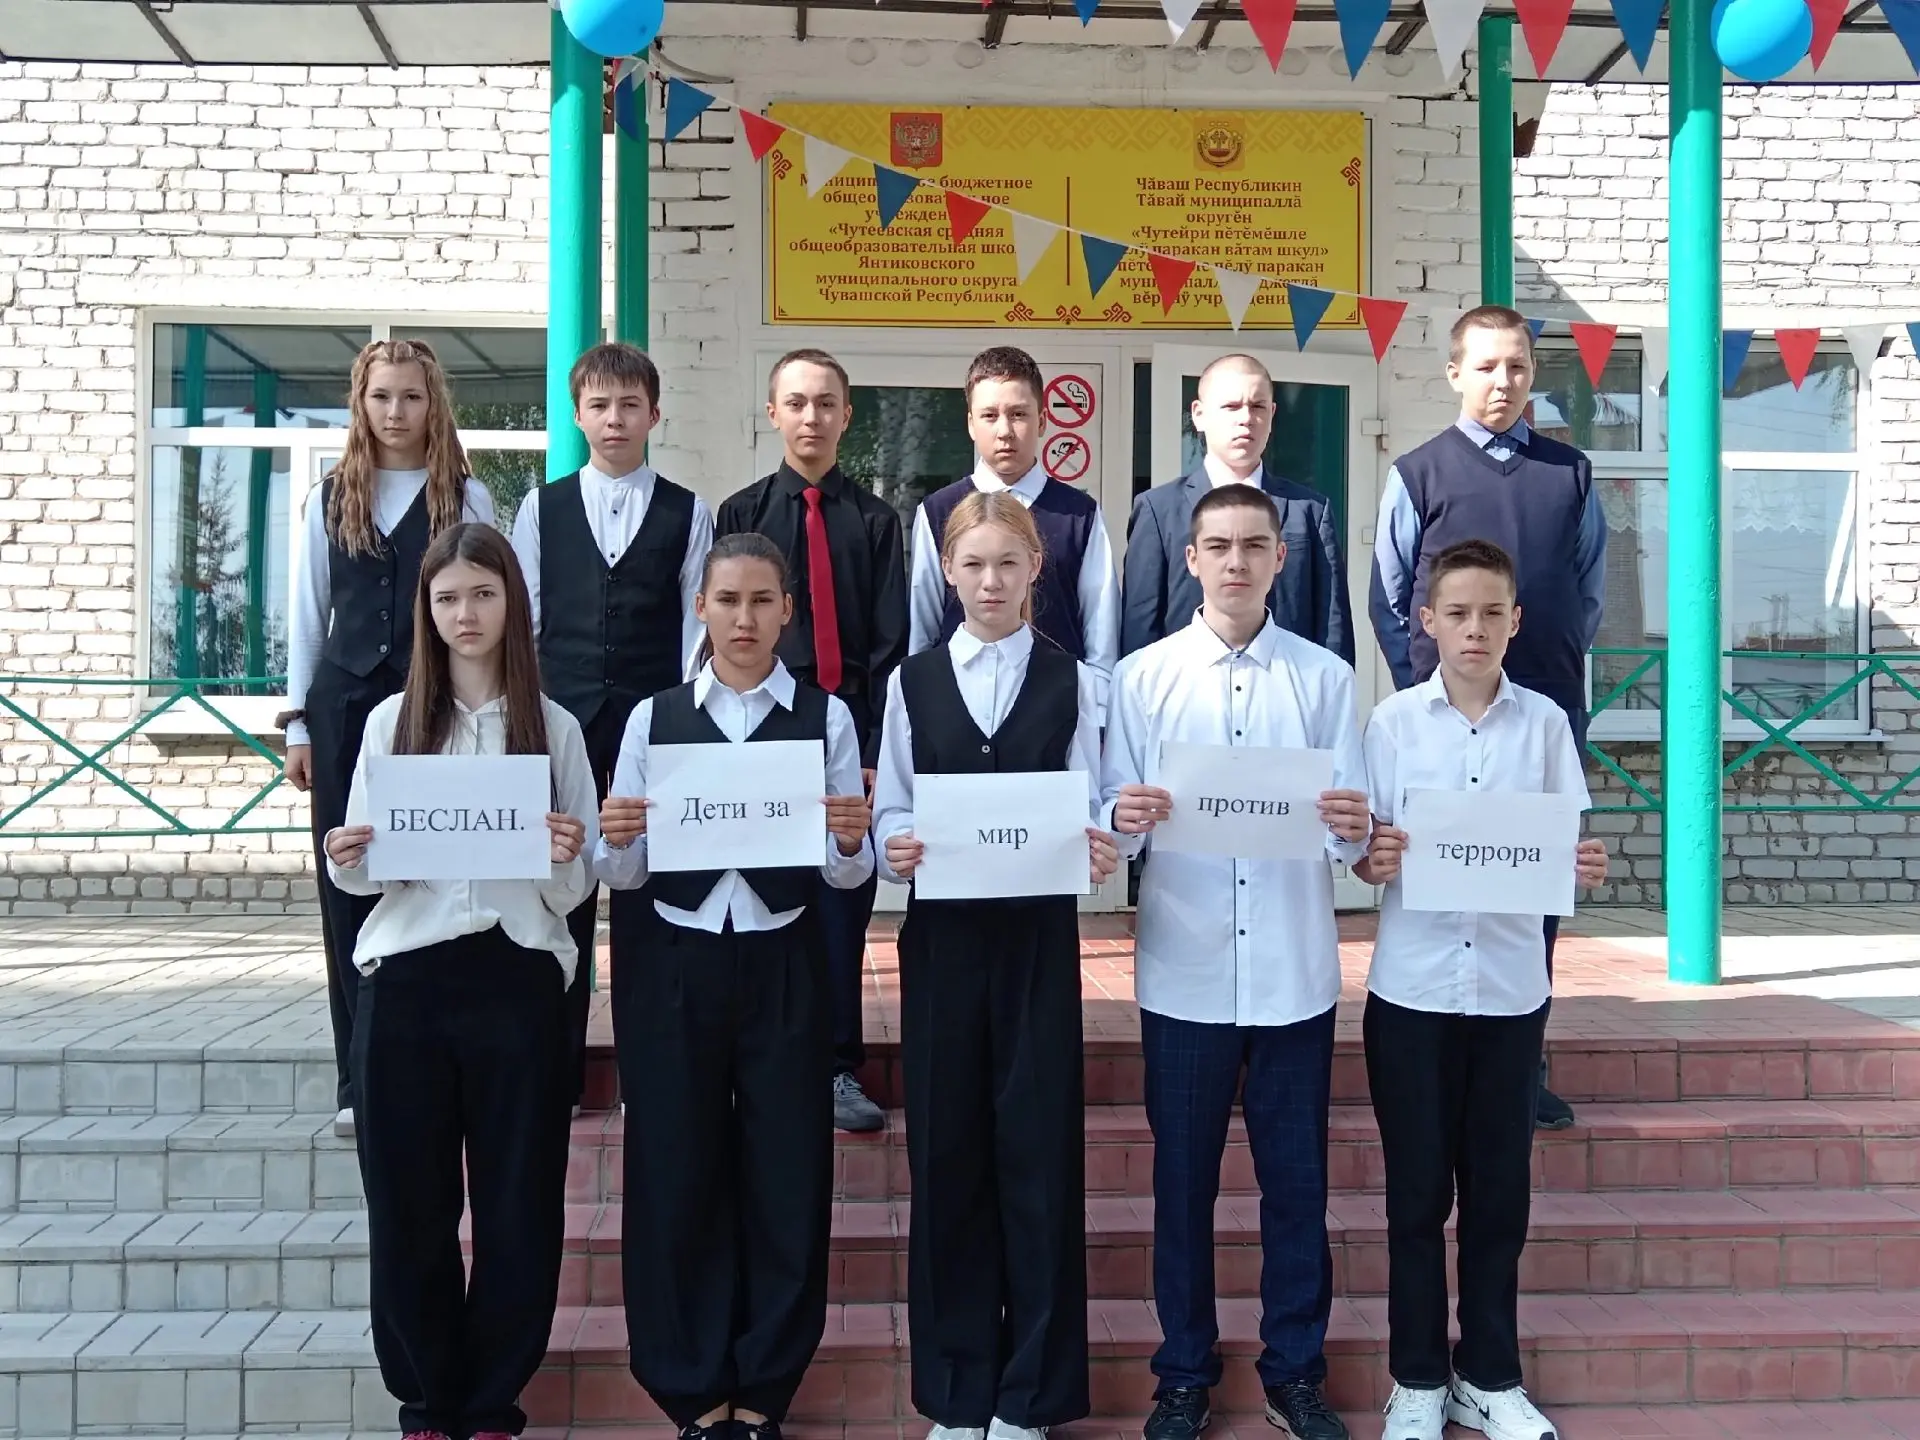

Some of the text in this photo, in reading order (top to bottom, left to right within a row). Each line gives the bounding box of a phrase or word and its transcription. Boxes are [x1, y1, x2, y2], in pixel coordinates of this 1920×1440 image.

[940, 175, 1033, 190] бюджетное
[1195, 178, 1302, 194] Республикин
[829, 222, 1004, 241] «Чутеевская срдняя
[1132, 225, 1210, 242] «Чутейри
[789, 238, 1017, 255] общеобразовательная шко
[1152, 245, 1220, 257] паракан
[1277, 246, 1329, 260] шкул»
[858, 255, 975, 270] Янтиковского
[1257, 261, 1324, 275] паракан
[815, 274, 1017, 290] муниципального округа
[819, 288, 1015, 306] Чувашской Республики
[680, 797, 790, 826] Дети за
[1198, 797, 1290, 818] против
[390, 808, 525, 832] БЕСЛАН.
[978, 828, 1028, 850] мир
[1436, 843, 1541, 868] террора
